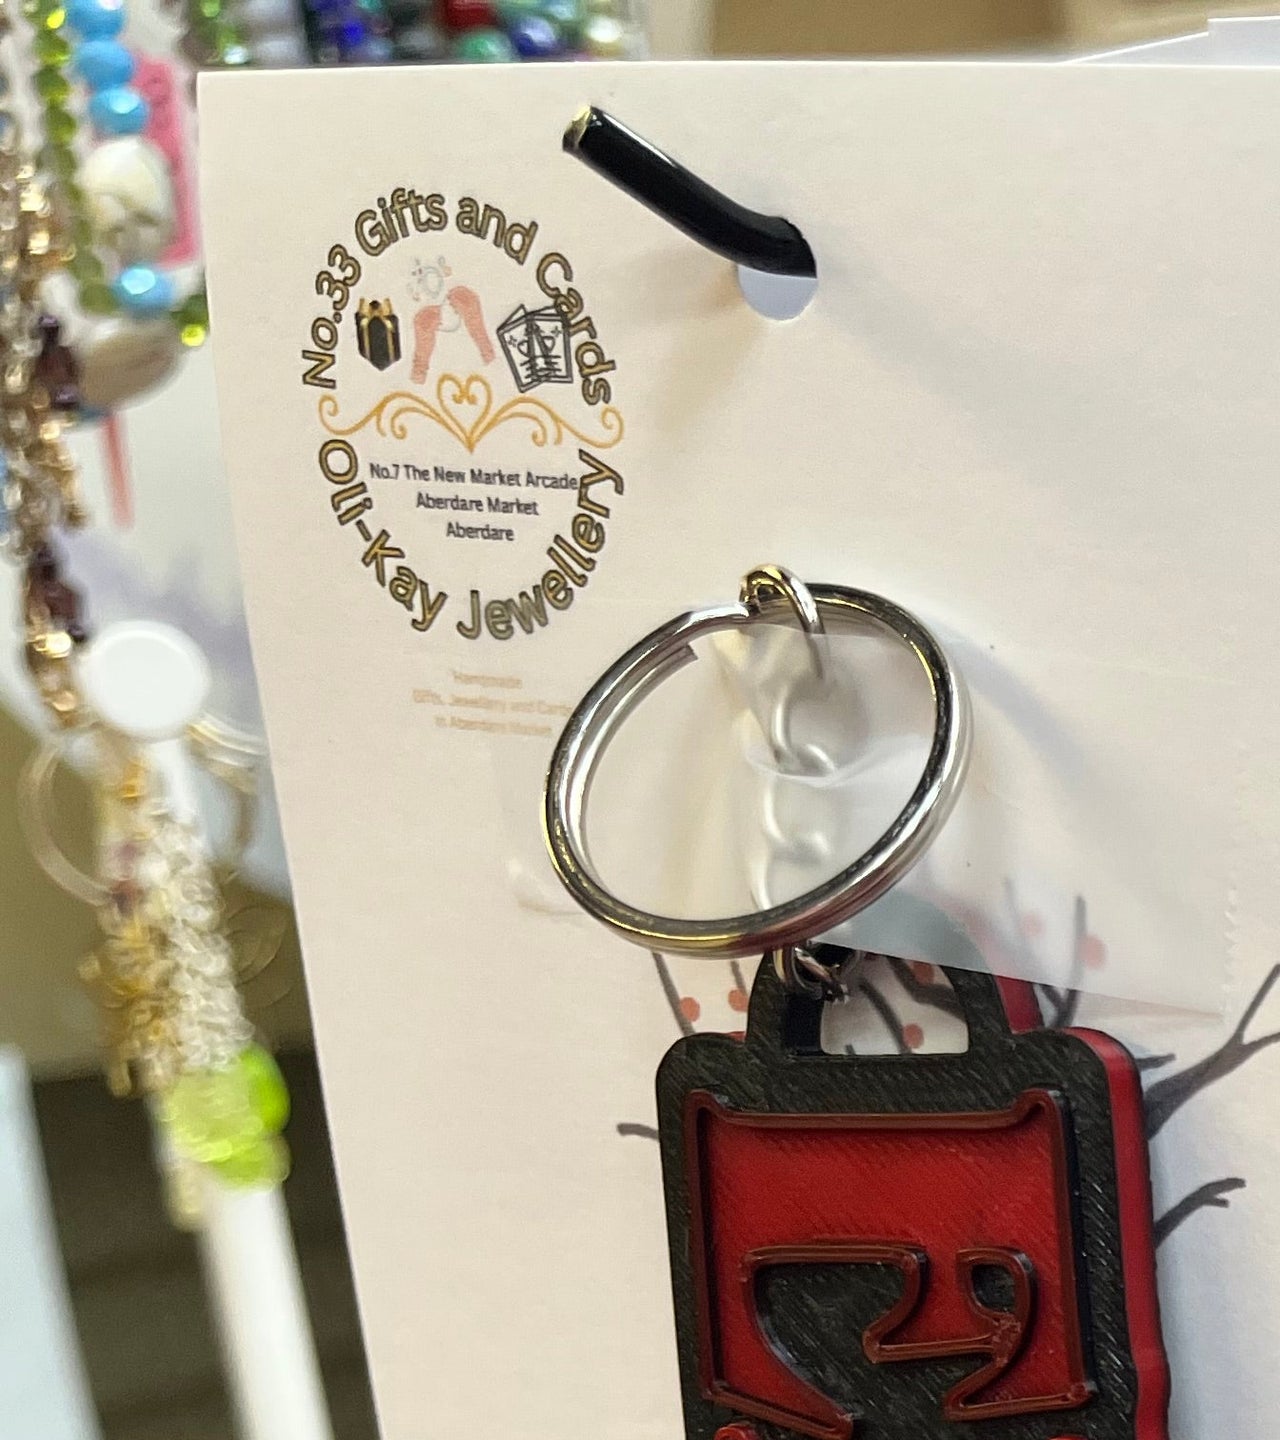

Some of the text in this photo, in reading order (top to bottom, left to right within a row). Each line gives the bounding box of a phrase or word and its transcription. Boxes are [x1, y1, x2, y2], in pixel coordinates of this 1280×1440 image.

[301, 187, 616, 405] No.33 Gifts and Cards
[404, 465, 430, 481] The
[434, 467, 465, 483] New
[470, 469, 520, 487] Market
[525, 472, 578, 490] Arcade
[417, 492, 539, 515] Aberdare Market
[319, 439, 624, 640] Oli-Kay Jewellery
[446, 522, 515, 541] Aberdare
